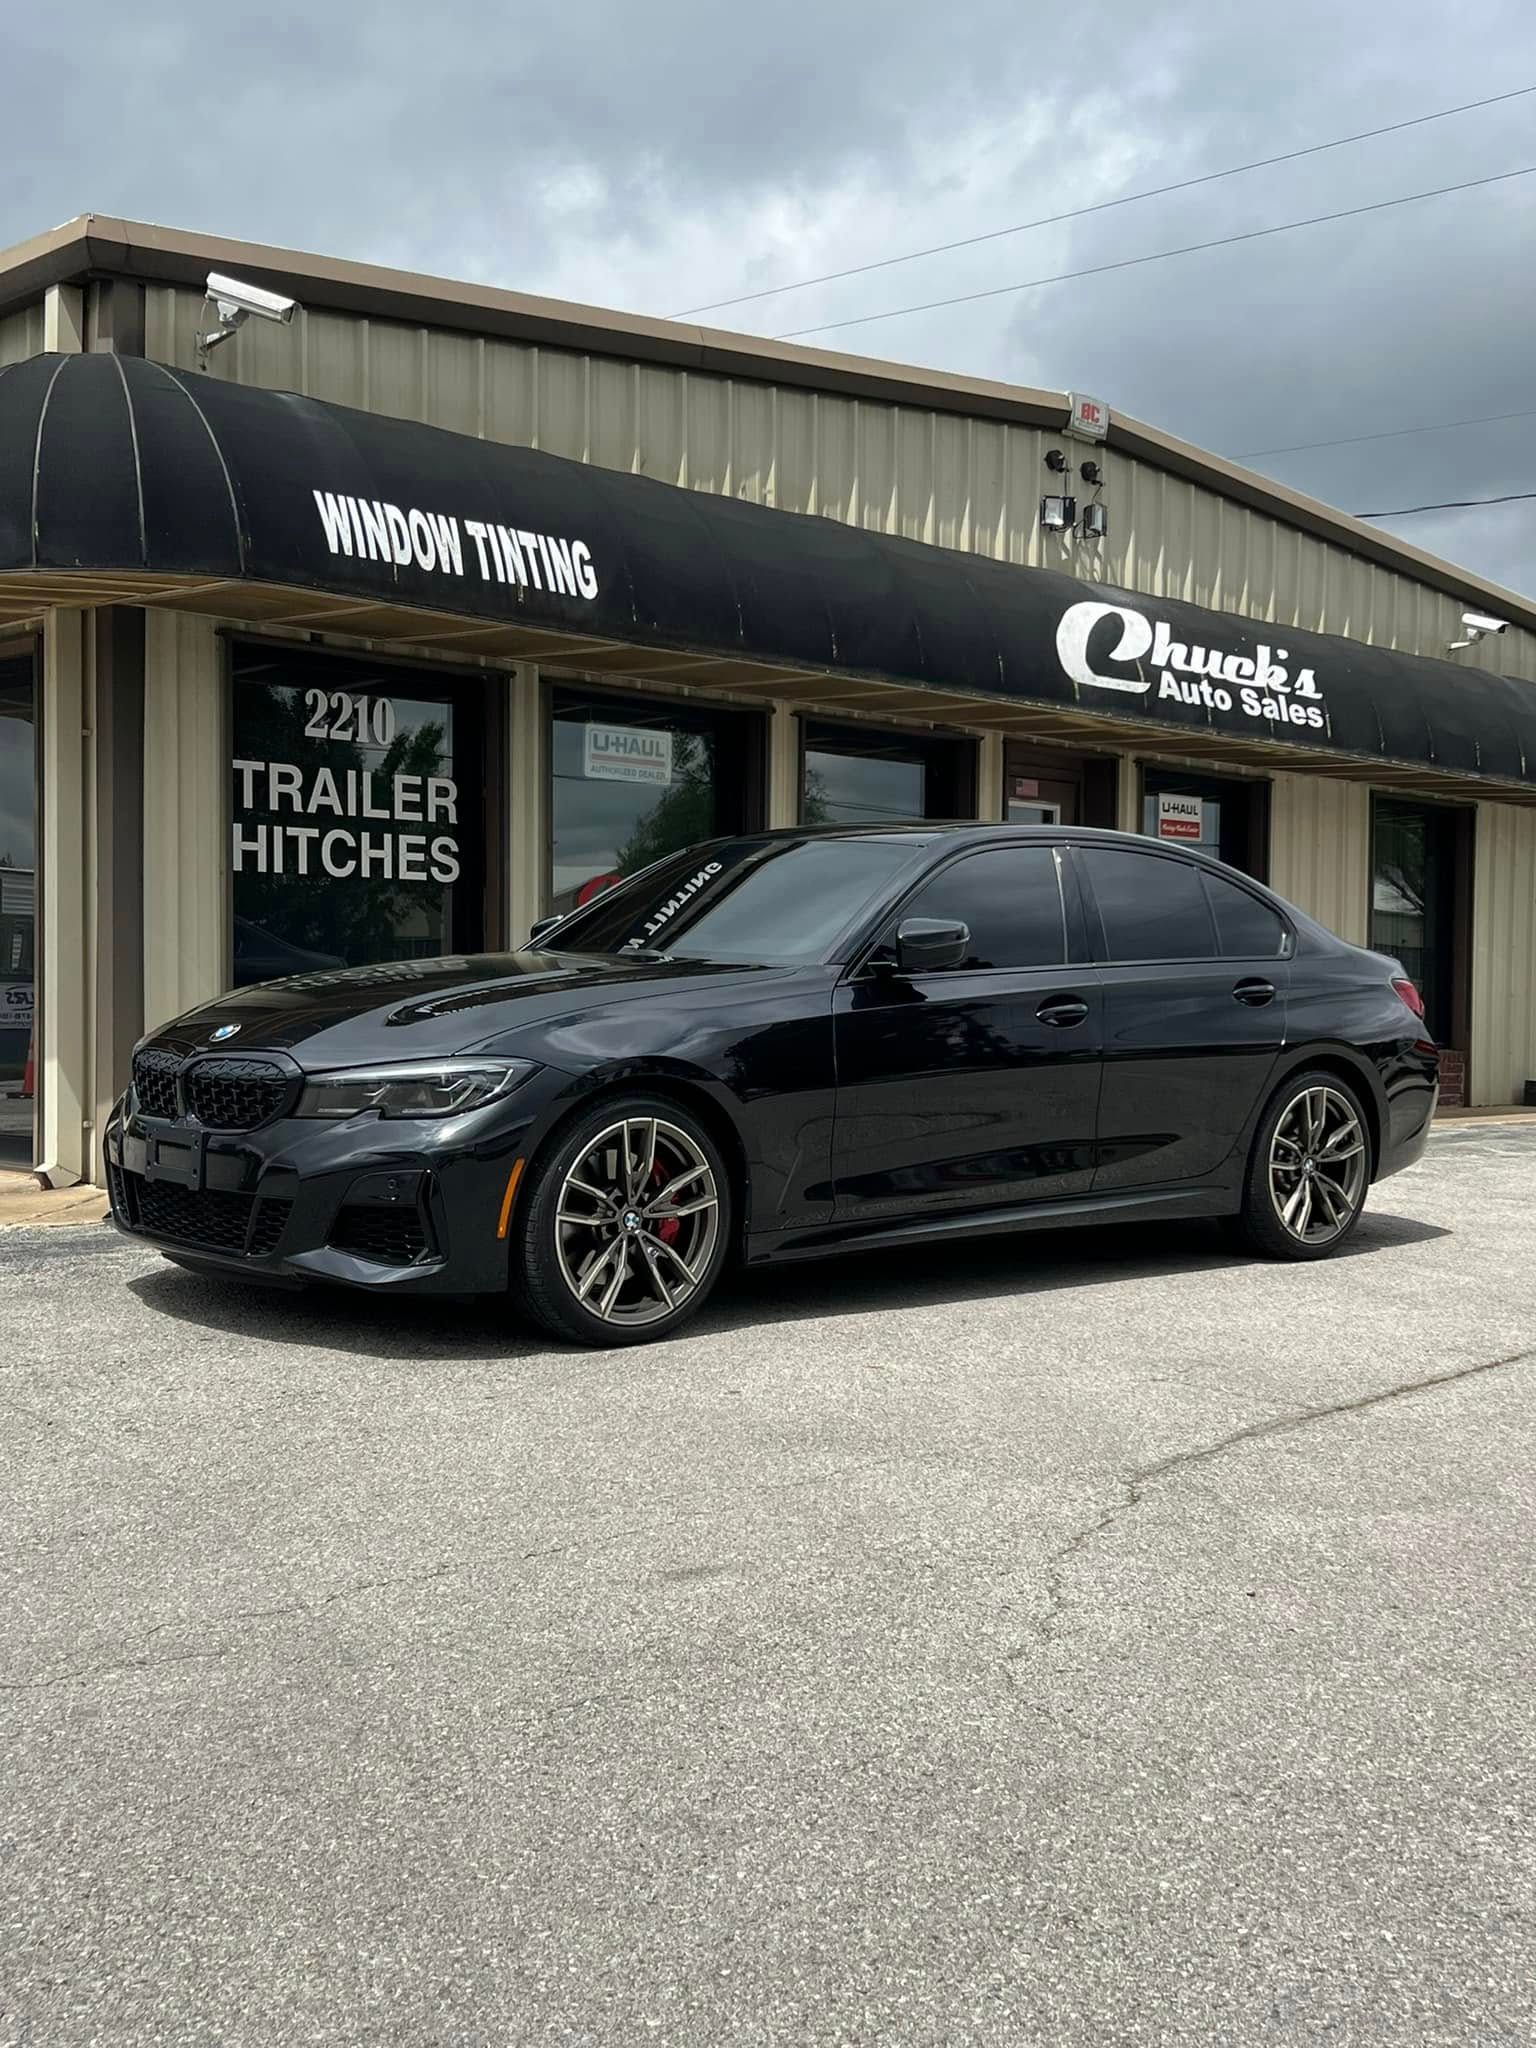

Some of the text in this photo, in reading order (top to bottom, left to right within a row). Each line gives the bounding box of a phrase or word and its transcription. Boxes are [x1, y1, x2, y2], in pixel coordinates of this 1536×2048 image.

[312, 489, 599, 600] WINDOW TINTING
[1056, 600, 1323, 699] Chuck's
[304, 688, 396, 746] 2210
[1158, 671, 1325, 729] Auto Sales
[232, 758, 459, 824] TRAILER
[232, 823, 461, 883] HITCHES
